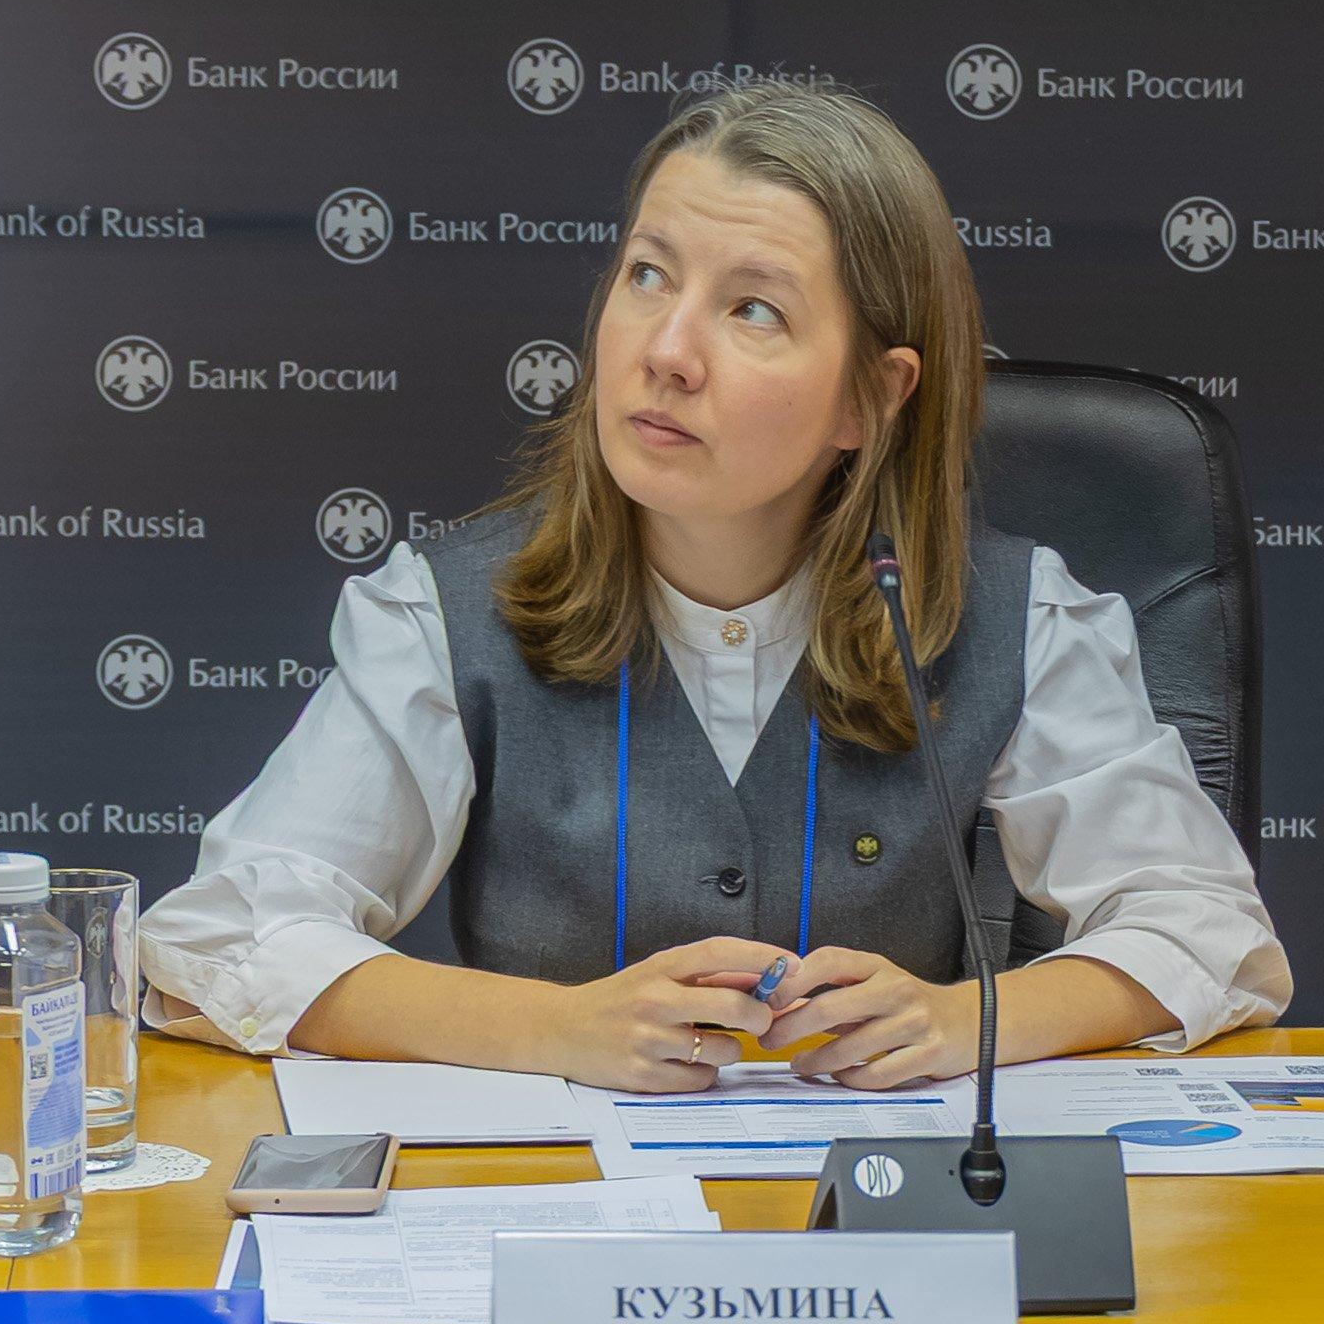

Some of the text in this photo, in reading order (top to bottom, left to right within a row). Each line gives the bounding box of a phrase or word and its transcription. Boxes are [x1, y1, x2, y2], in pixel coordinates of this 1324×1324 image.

[187, 56, 398, 90] Банк России
[600, 61, 679, 92] Bank
[1037, 67, 1243, 100] Банк России
[56, 204, 91, 237] of
[101, 207, 205, 239] Russia
[409, 211, 618, 244] Банк России
[188, 359, 397, 391] Банк России
[57, 505, 92, 537] of
[102, 508, 205, 539] Russia
[189, 658, 269, 687] Банк
[58, 803, 94, 834] of
[103, 805, 206, 834] Russia
[1260, 816, 1317, 839] анк
[615, 1286, 894, 1320] КУЗЬМИНА
